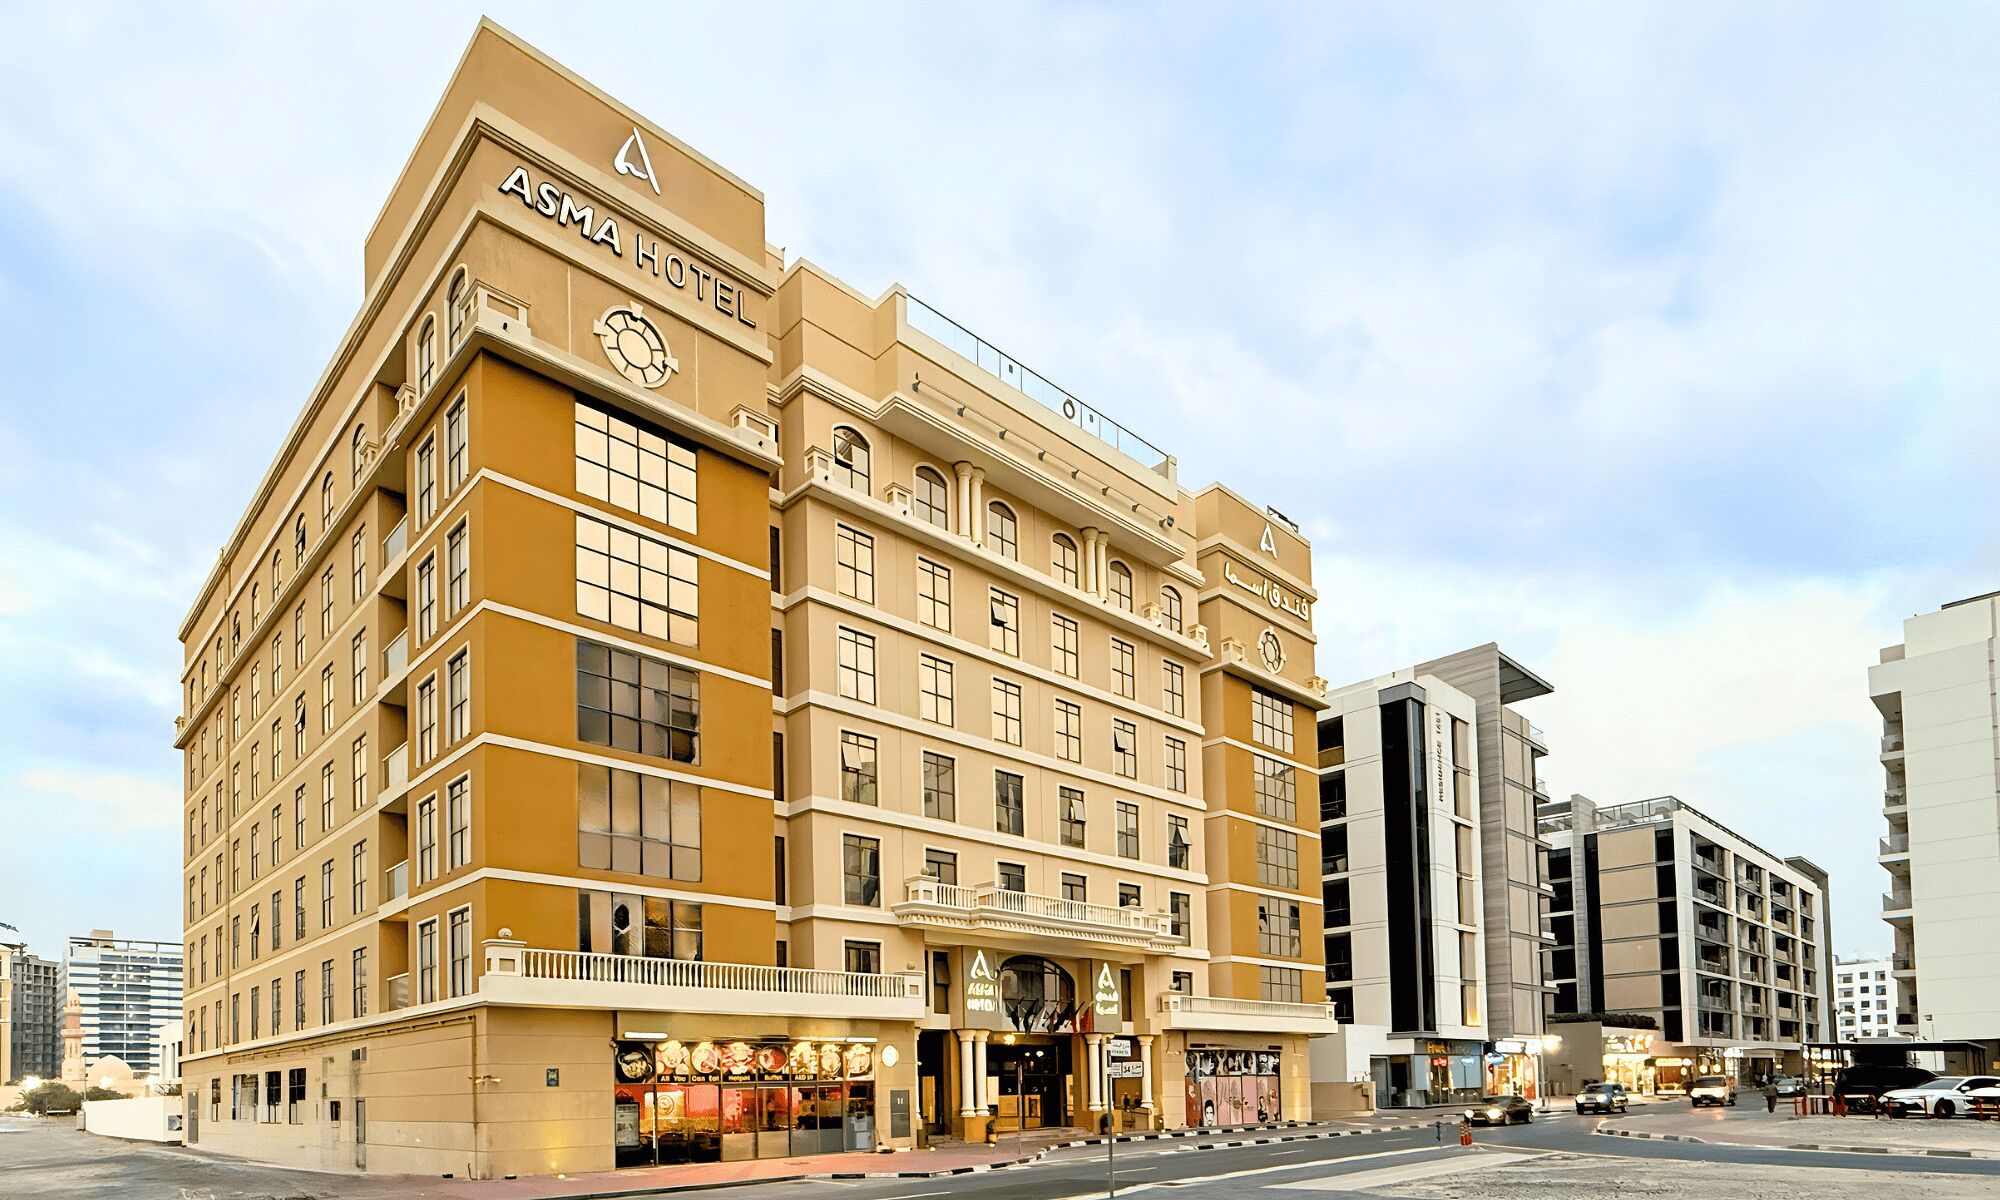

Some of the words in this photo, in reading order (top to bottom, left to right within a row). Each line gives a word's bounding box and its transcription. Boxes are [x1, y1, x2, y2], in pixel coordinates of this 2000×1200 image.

[498, 165, 623, 257] ASMA
[636, 233, 756, 328] HOTEL
[1268, 583, 1309, 622] فندق
[1436, 740, 1444, 802] RESIDENCE
